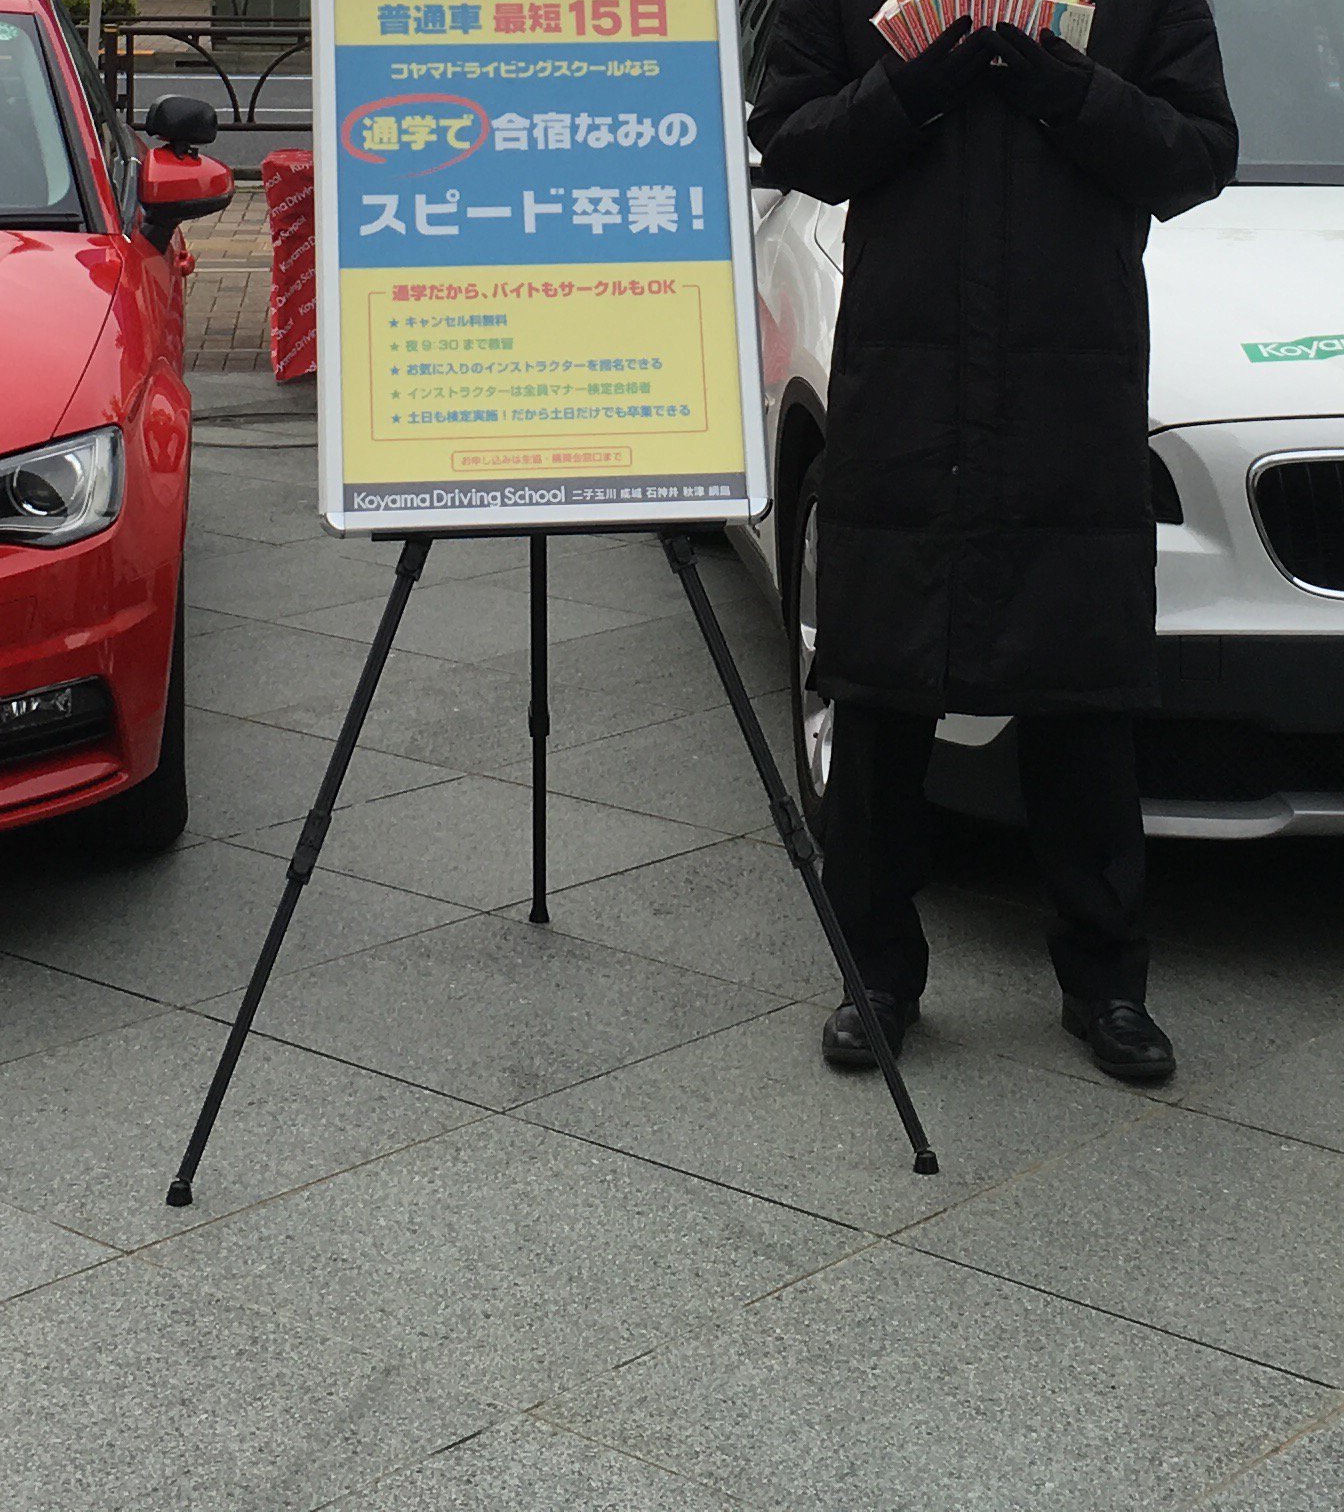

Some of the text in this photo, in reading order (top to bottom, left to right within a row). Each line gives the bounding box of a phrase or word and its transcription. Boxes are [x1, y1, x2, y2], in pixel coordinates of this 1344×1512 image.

[377, 3, 482, 36] 普通車
[390, 59, 661, 82] コヤマドライビングスクールなら
[361, 112, 698, 152] 通学で 合宿なみの
[358, 185, 704, 237] スピード卒業!
[353, 491, 430, 512] Koyama
[433, 488, 502, 508] Driving
[504, 485, 566, 504] School
